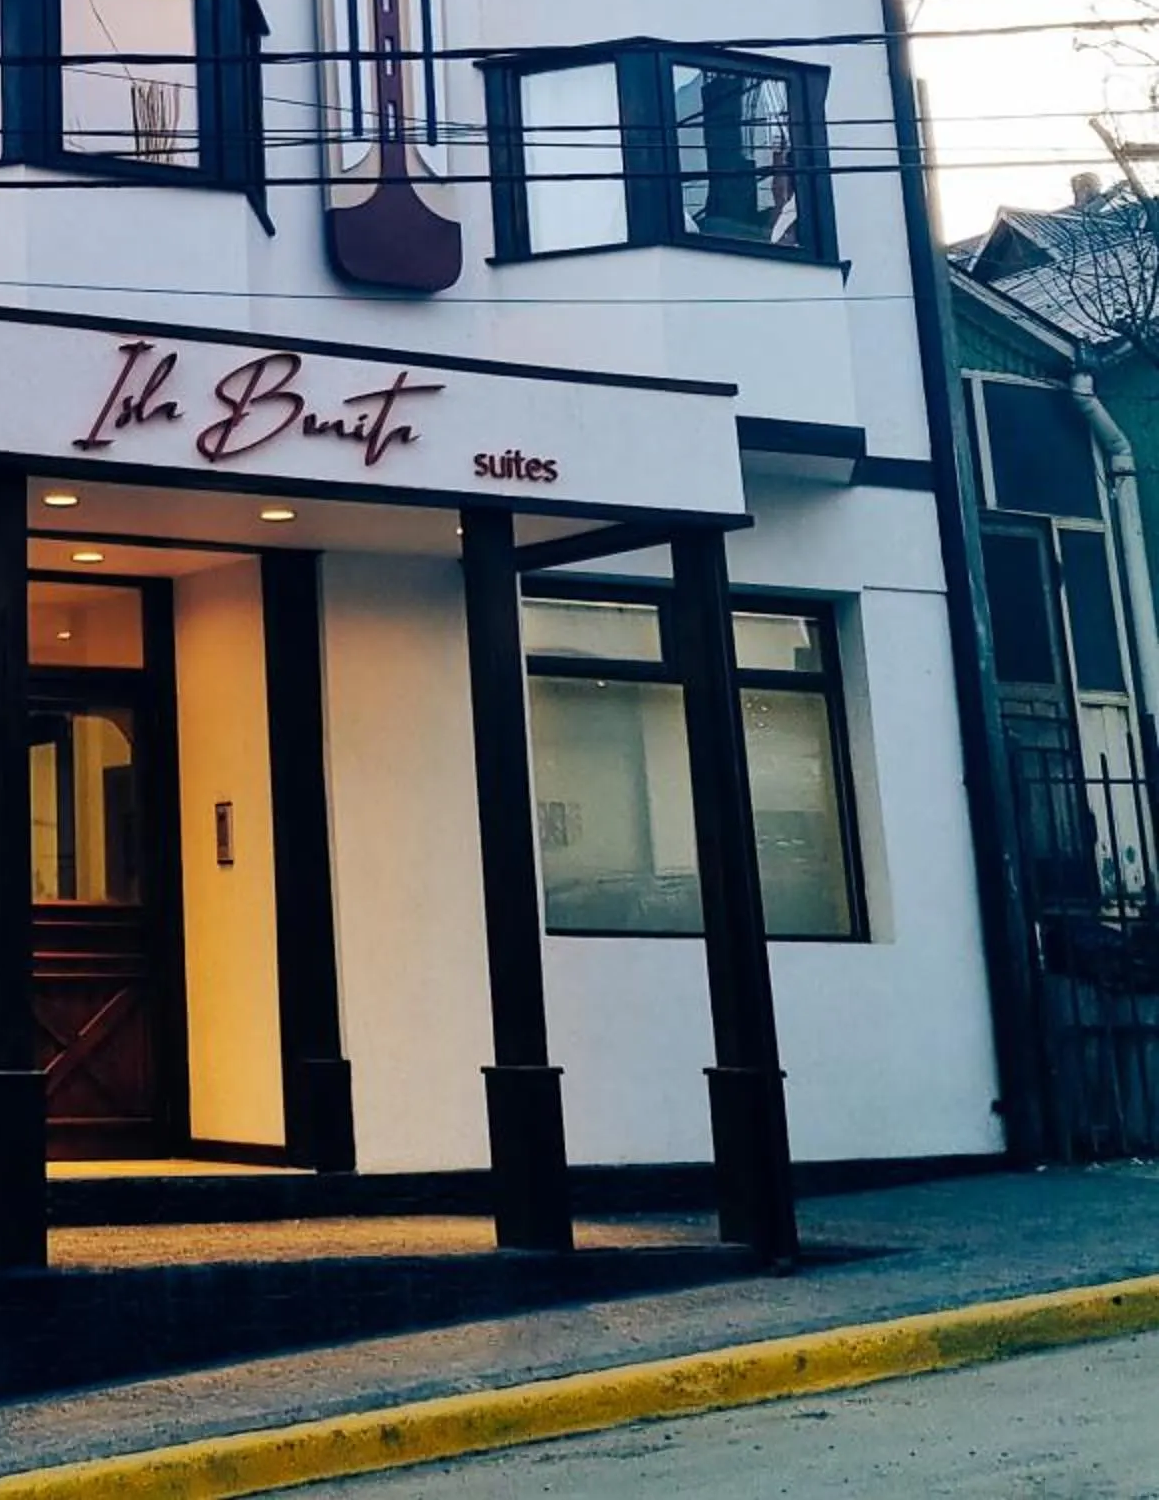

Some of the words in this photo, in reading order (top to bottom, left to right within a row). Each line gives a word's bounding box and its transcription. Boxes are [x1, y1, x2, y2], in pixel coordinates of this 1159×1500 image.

[72, 340, 185, 451] Isla
[196, 353, 447, 467] Bonita
[473, 449, 558, 483] suites
